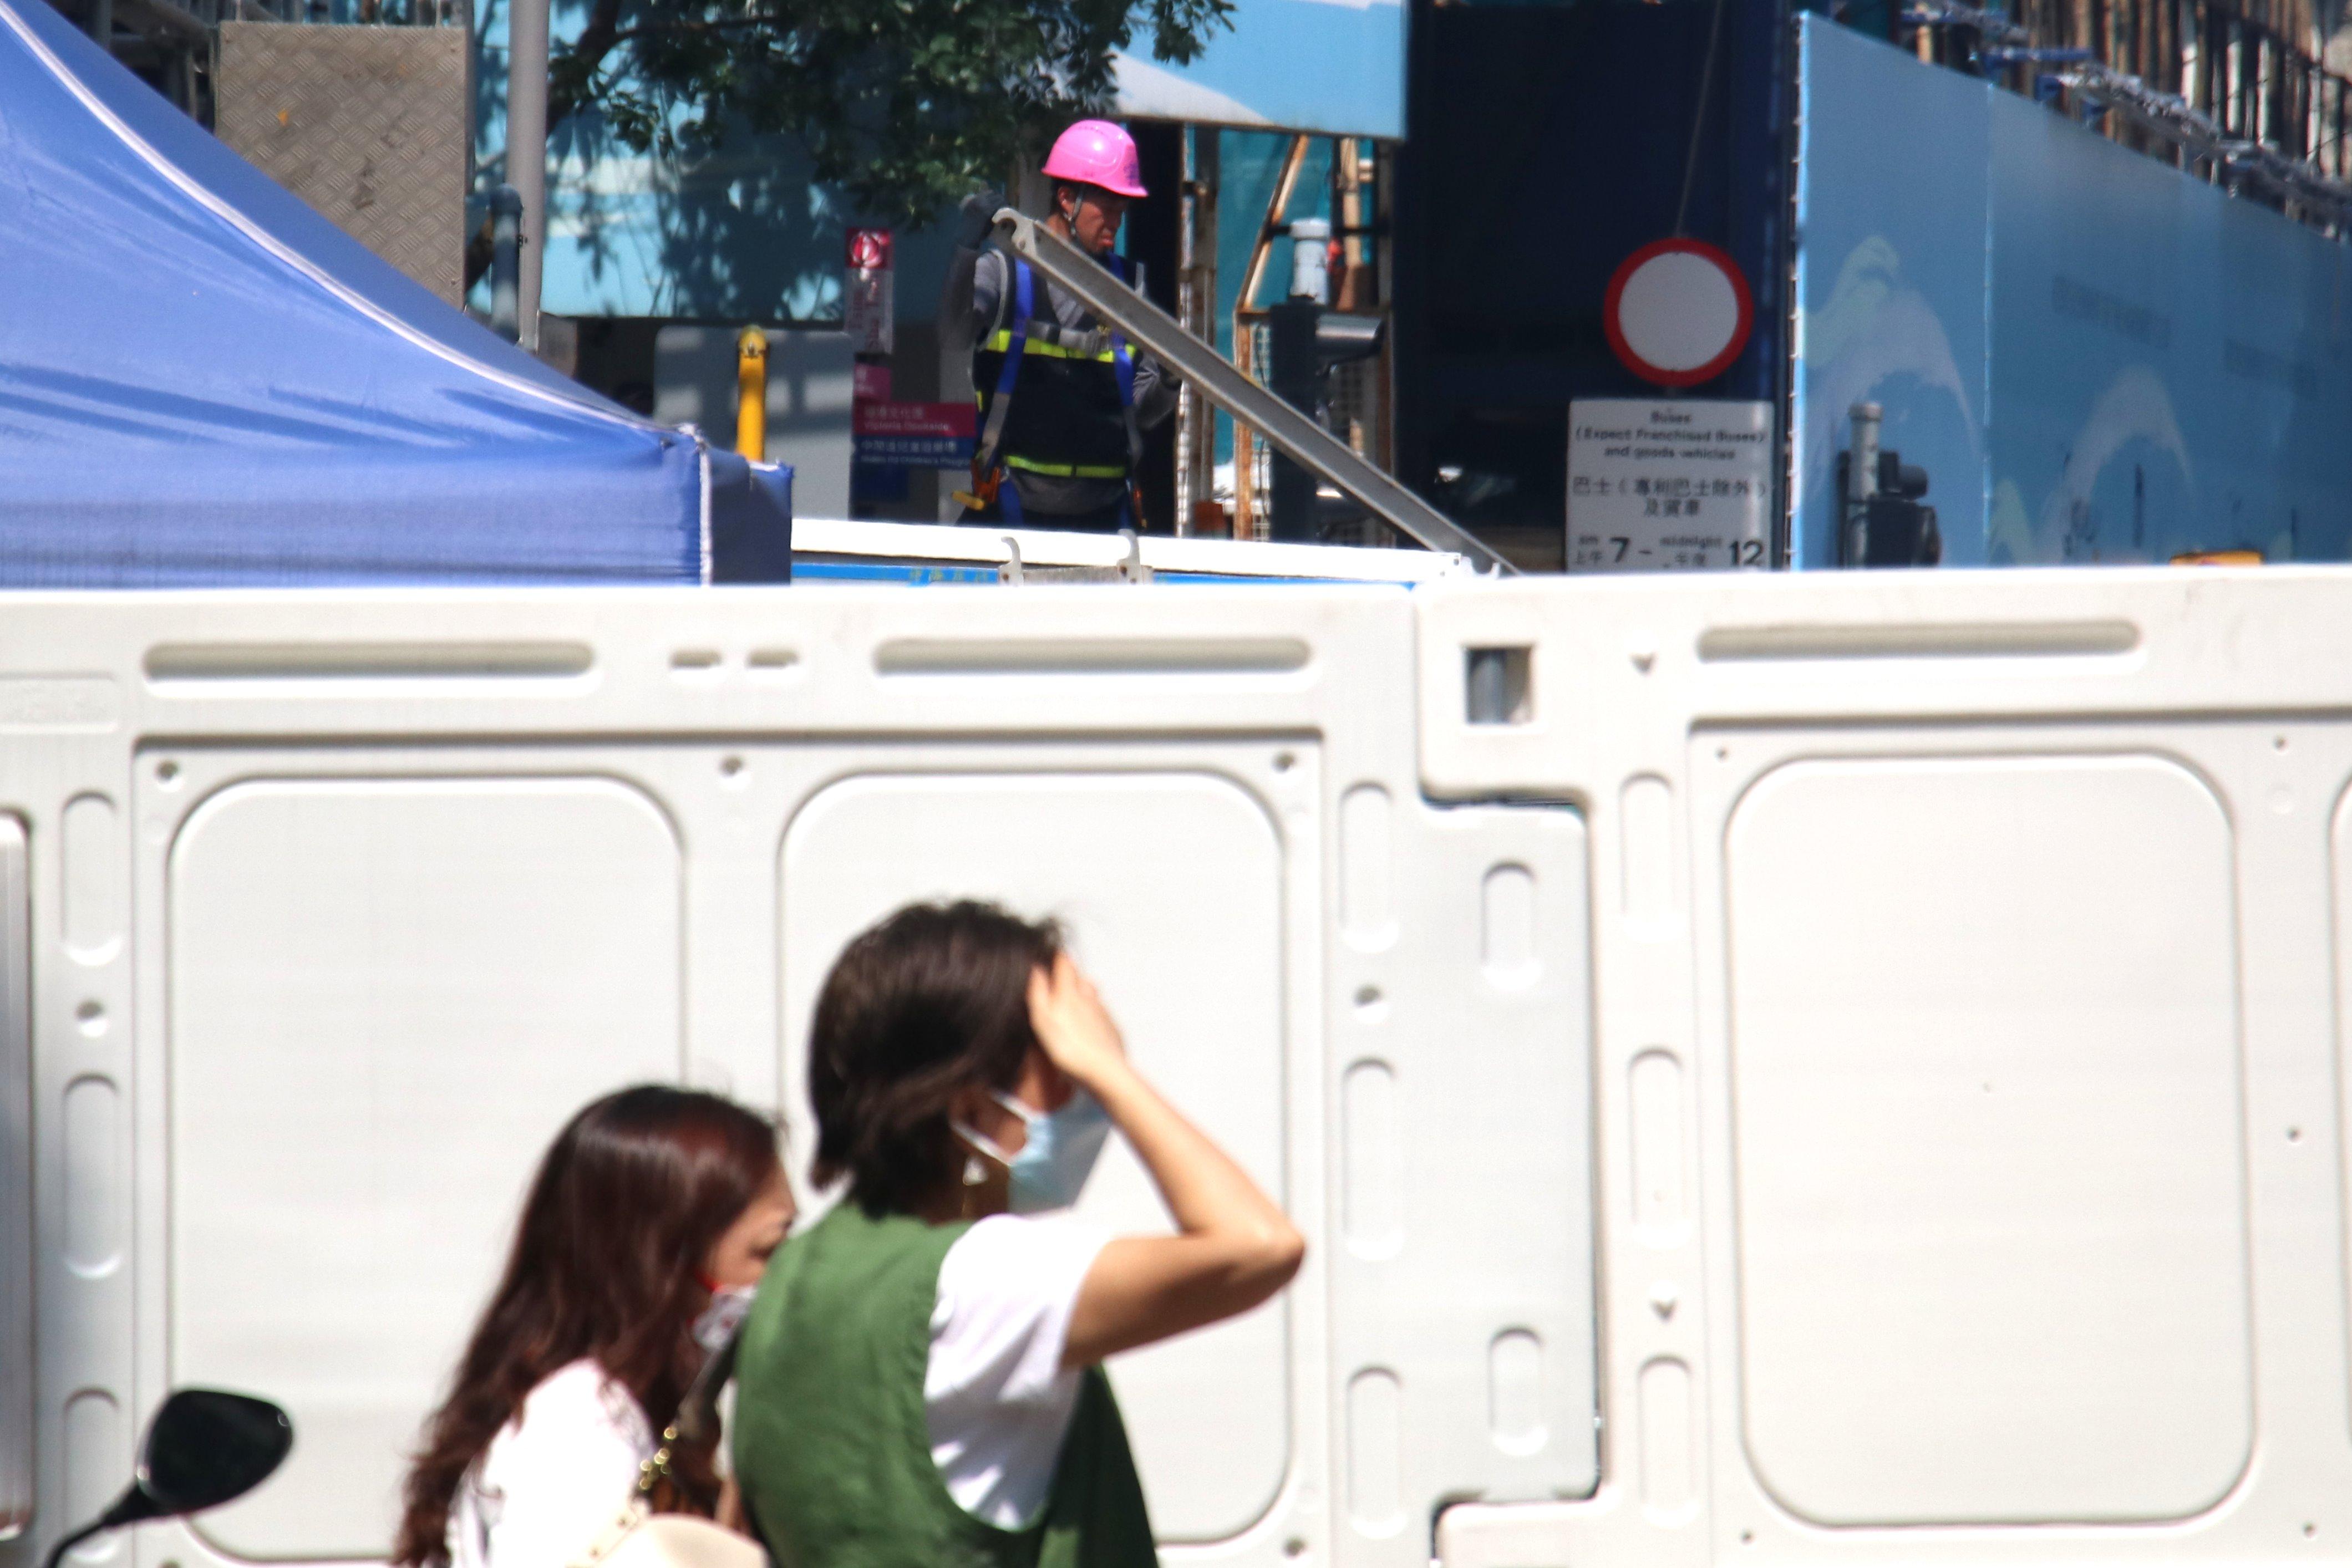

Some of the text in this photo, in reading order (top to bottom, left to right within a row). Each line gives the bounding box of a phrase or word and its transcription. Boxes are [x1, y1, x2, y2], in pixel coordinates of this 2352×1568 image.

[1604, 446, 1629, 457] and
[1679, 448, 1736, 460] vehicles
[1609, 536, 1630, 563] 7
[1728, 540, 1764, 566] 12
